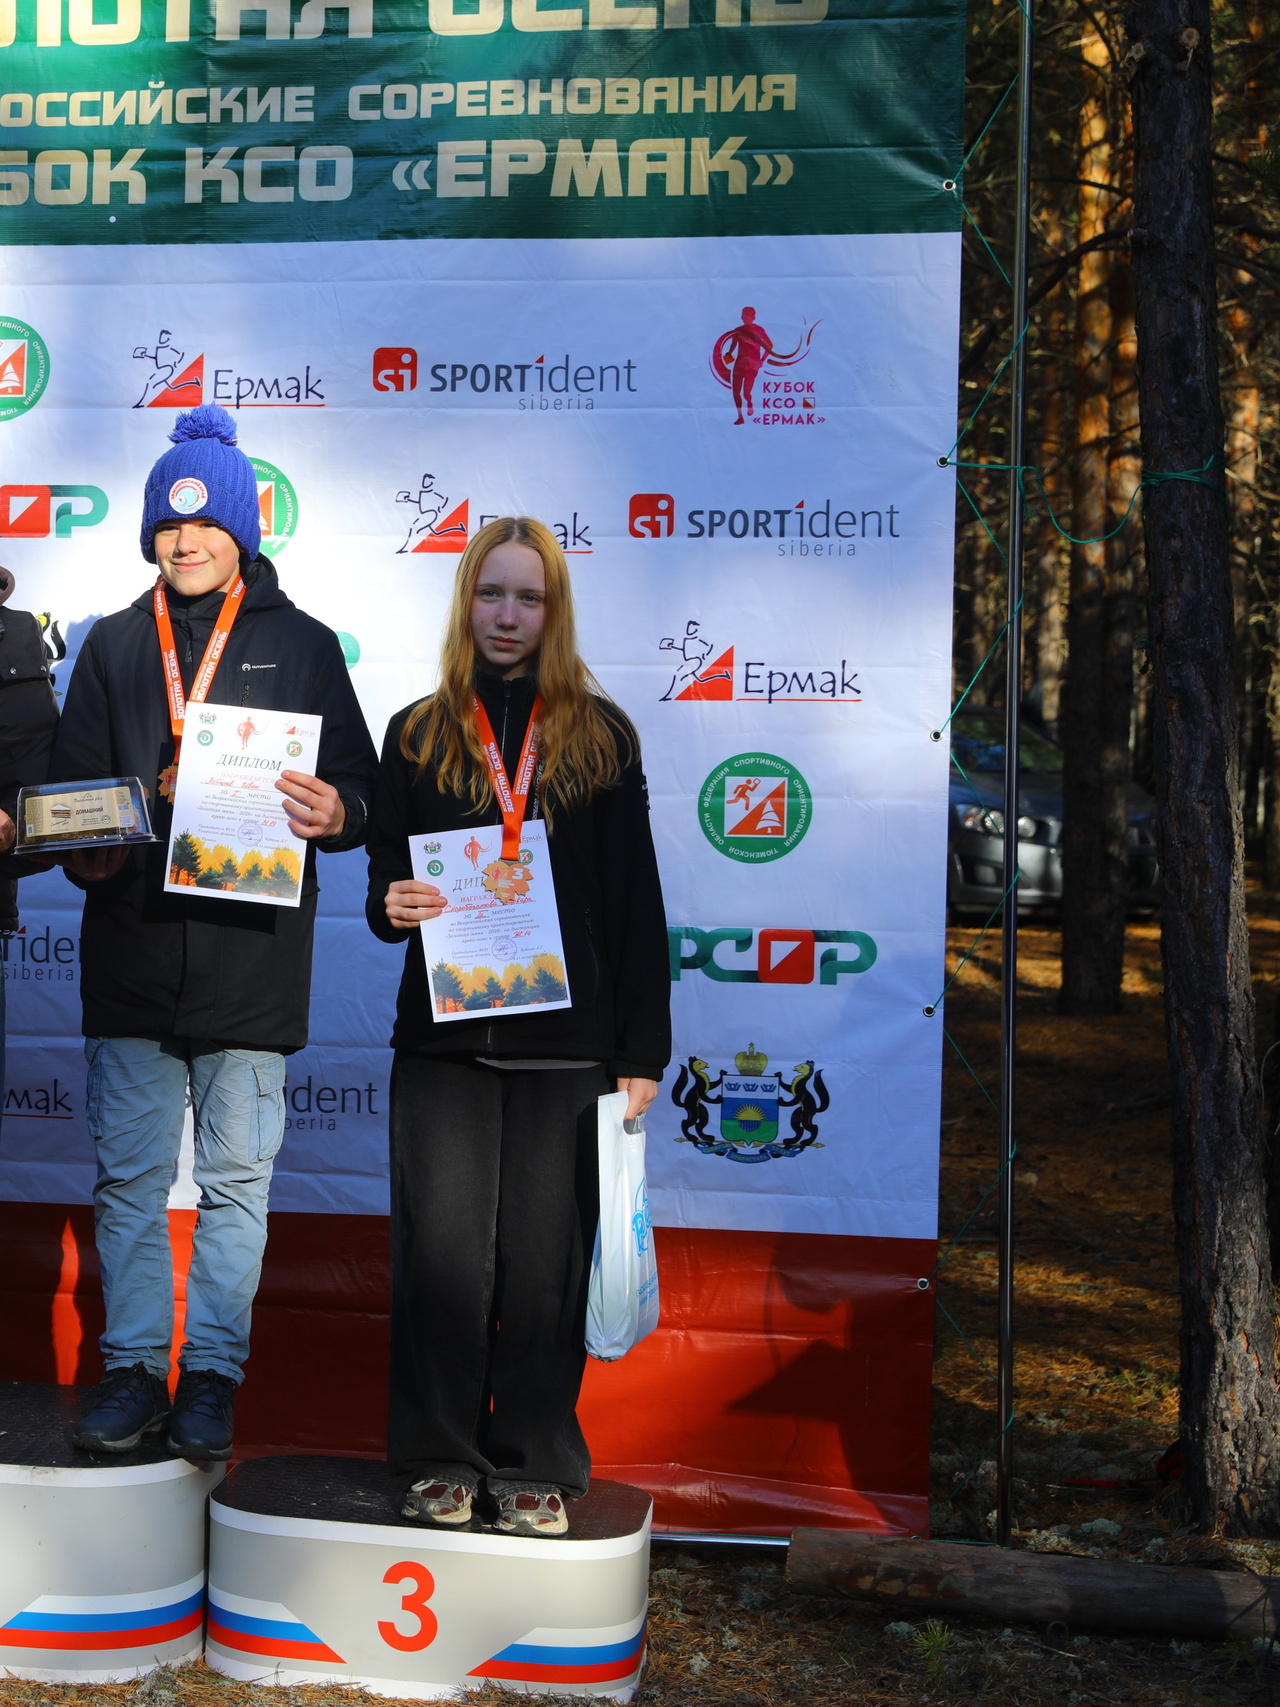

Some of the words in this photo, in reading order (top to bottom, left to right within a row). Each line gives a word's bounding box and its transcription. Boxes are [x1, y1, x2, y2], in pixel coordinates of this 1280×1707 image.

[347, 73, 797, 121] СОРЕВНОВАНИЯ
[184, 145, 354, 204] КСО
[391, 136, 795, 198] «ЕРМАК»
[22, 340, 46, 406] ОРИЕНТИРОВАНИЯ
[213, 365, 325, 409] Ермак
[430, 353, 638, 393] SPORTident
[762, 381, 816, 394] КУБОК
[518, 394, 595, 411] siberia
[762, 397, 796, 409] КСО
[752, 413, 826, 426] «ЕРМАК»
[687, 498, 901, 540] SPORTident
[778, 540, 857, 558] siberia
[169, 648, 179, 679] ОСЕНЬ
[197, 660, 217, 702] ЗОЛОТАЯ
[212, 631, 228, 660] ОСЕНЬ
[743, 659, 862, 705] Ермак
[173, 680, 185, 721] ЗОЛОТАЯ
[216, 753, 283, 772] ДИПЛОМ
[488, 741, 503, 771] ОСЕНЬ
[733, 757, 791, 776] СПОРТИВНОГО
[520, 754, 537, 796] ЗОЛОТАЯ
[703, 766, 730, 808] ФЕДЕРАЦИЯ
[497, 771, 515, 813] ЗОЛОТАЯ
[703, 812, 725, 846] ОБЛАСТИ
[783, 779, 807, 847] ОРИЕНТИРОВАНИЯ
[522, 833, 543, 843] Ермак
[728, 845, 779, 859] ТЮМЕНСКОЙ
[453, 876, 485, 893] ДИП
[512, 867, 524, 880] 3
[460, 893, 496, 903] НАГРАЖД
[491, 907, 516, 916] место
[3, 965, 74, 982] siberia
[5, 1078, 73, 1115] мак
[376, 1560, 438, 1653] 3
